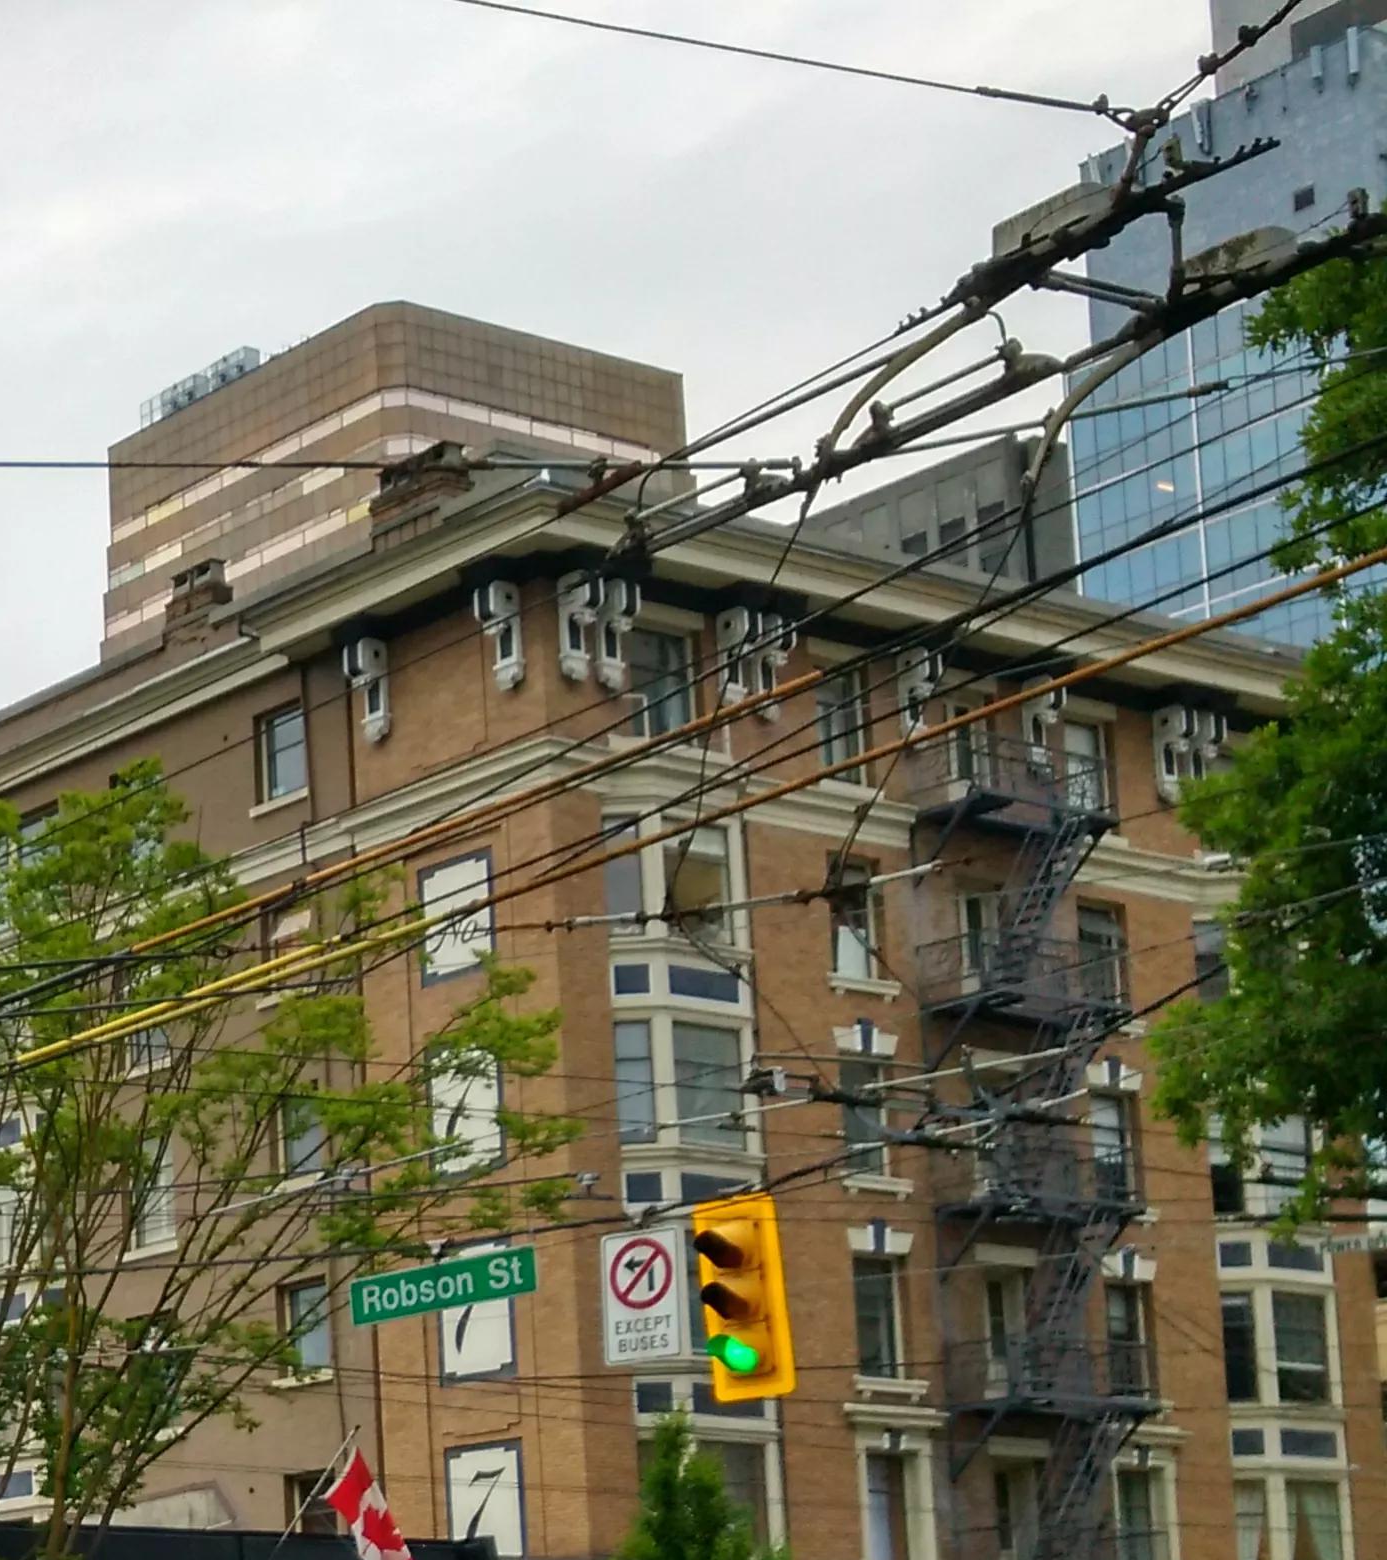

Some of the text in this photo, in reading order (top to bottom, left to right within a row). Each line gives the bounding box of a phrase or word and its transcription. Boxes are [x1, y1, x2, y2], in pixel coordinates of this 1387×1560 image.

[362, 1256, 524, 1315] Robson St
[614, 1314, 672, 1336] EXCEPT
[618, 1333, 670, 1354] BUSES
